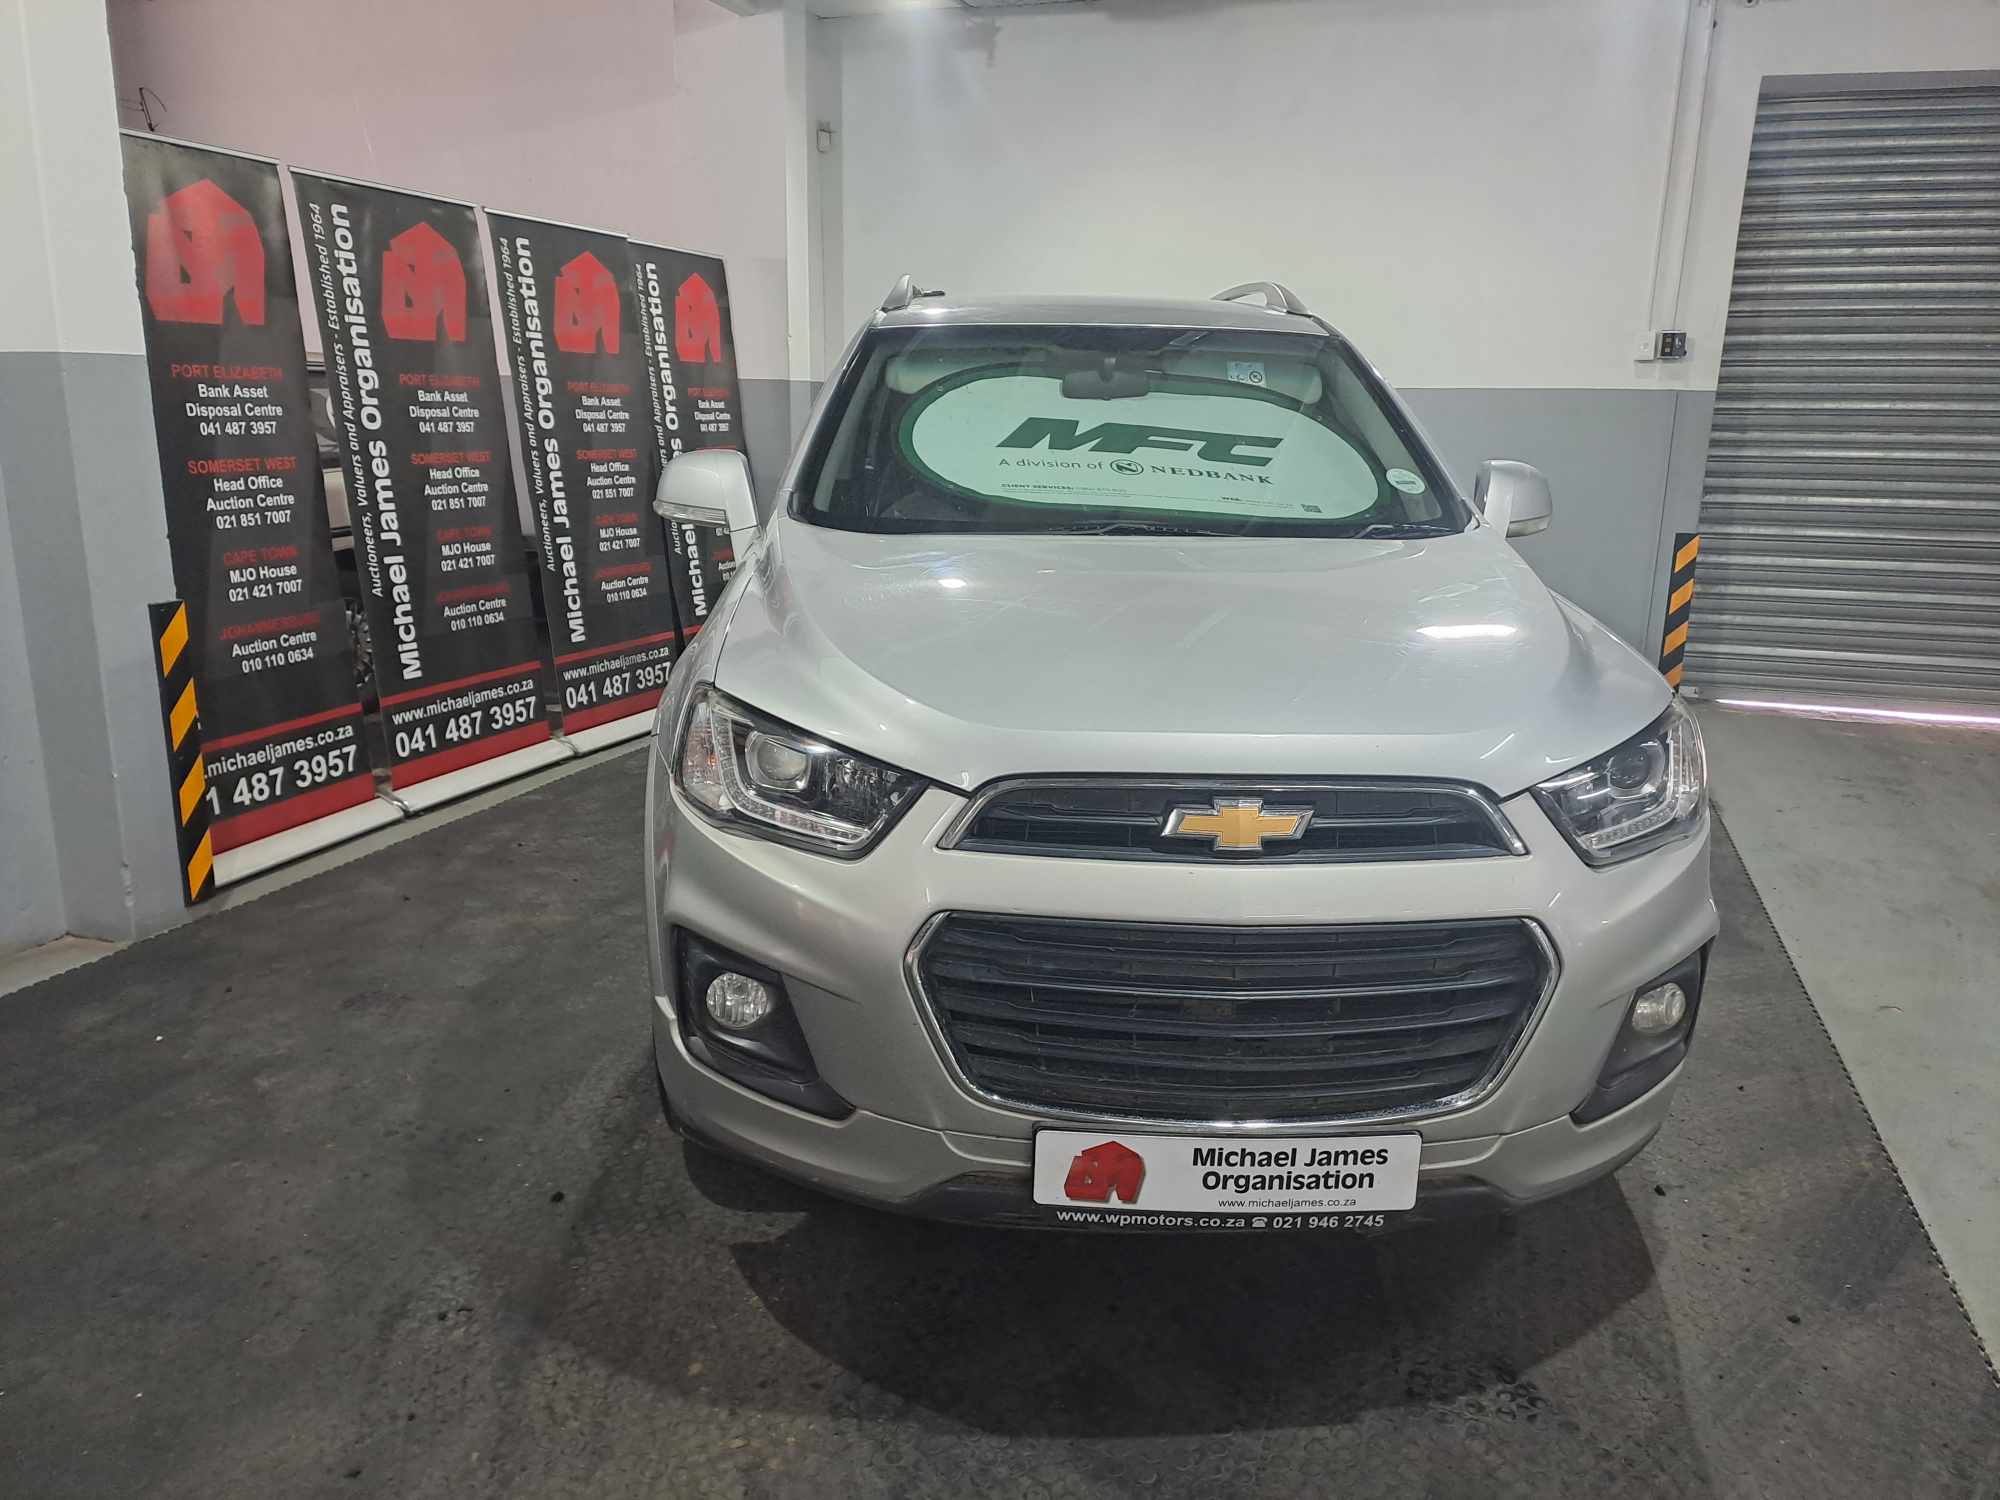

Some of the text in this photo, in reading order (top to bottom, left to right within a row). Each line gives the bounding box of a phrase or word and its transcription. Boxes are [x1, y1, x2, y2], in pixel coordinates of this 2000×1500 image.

[309, 202, 327, 241] 1964
[315, 243, 341, 331] Established
[504, 271, 522, 345] Established
[170, 363, 209, 379] PORT
[198, 383, 269, 399] Bank Asset
[334, 342, 356, 421] Appraisers
[517, 354, 534, 421] Appraisers
[417, 390, 468, 402] Bank Asset
[581, 395, 600, 406] Bank
[185, 402, 284, 420] Disposal Centre
[409, 405, 480, 420] Disposal Centre
[575, 409, 629, 421] Disposal Centre
[199, 420, 277, 436] 041 487 3957
[343, 420, 360, 451] and
[419, 422, 474, 433] 041 487 3957
[525, 422, 538, 447] and
[331, 203, 423, 681] Michael James Organisation
[515, 237, 586, 643] Michael James Organisation
[646, 262, 707, 617] Michael Organisation
[995, 416, 1285, 467] MFC
[187, 458, 261, 475] SOMERSET
[429, 466, 480, 480] Head Office
[531, 449, 545, 495] Valuers
[590, 462, 629, 473] Head Office
[999, 458, 1010, 467] A
[1016, 458, 1081, 469] division
[1087, 461, 1105, 470] of
[1150, 464, 1273, 485] NEDBANK
[213, 475, 284, 492] Head Office
[352, 454, 369, 508] Valuers
[424, 481, 489, 496] Auction Centre
[587, 475, 637, 487] Auction Centre
[206, 493, 295, 512] Auction Centre
[431, 496, 486, 511] 021 851 7007
[216, 510, 292, 529] 021 851 7007
[538, 499, 556, 573] Auctioneers,
[615, 527, 637, 536] House
[671, 520, 682, 555] Auctio
[362, 512, 384, 598] Auctioneers,
[441, 542, 491, 556] MJO House
[441, 554, 495, 572] 021 421 7007
[229, 564, 297, 584] MJO House
[601, 576, 649, 590] Auction Centre
[228, 579, 303, 602] 021 421 7007
[443, 598, 507, 617] Auction Centre
[450, 612, 505, 632] 010 110 0634
[232, 631, 318, 658] Auction Centre
[241, 646, 314, 673] 010 110 0634
[563, 645, 669, 681] www.michaeljames.co.za
[565, 661, 671, 710] 041 487 3957
[392, 677, 534, 726] www.michaeljames.co.za
[395, 696, 536, 759] 041 487 3957
[232, 766, 285, 807] 487
[293, 744, 358, 788] 3957
[1192, 1147, 1389, 1167] Michael James
[1202, 1170, 1375, 1194] Organisation
[1218, 1198, 1357, 1209] www.michaeljames.co.za
[1056, 1210, 1385, 1229] www.wpmotors.co.za 021 946 2745
